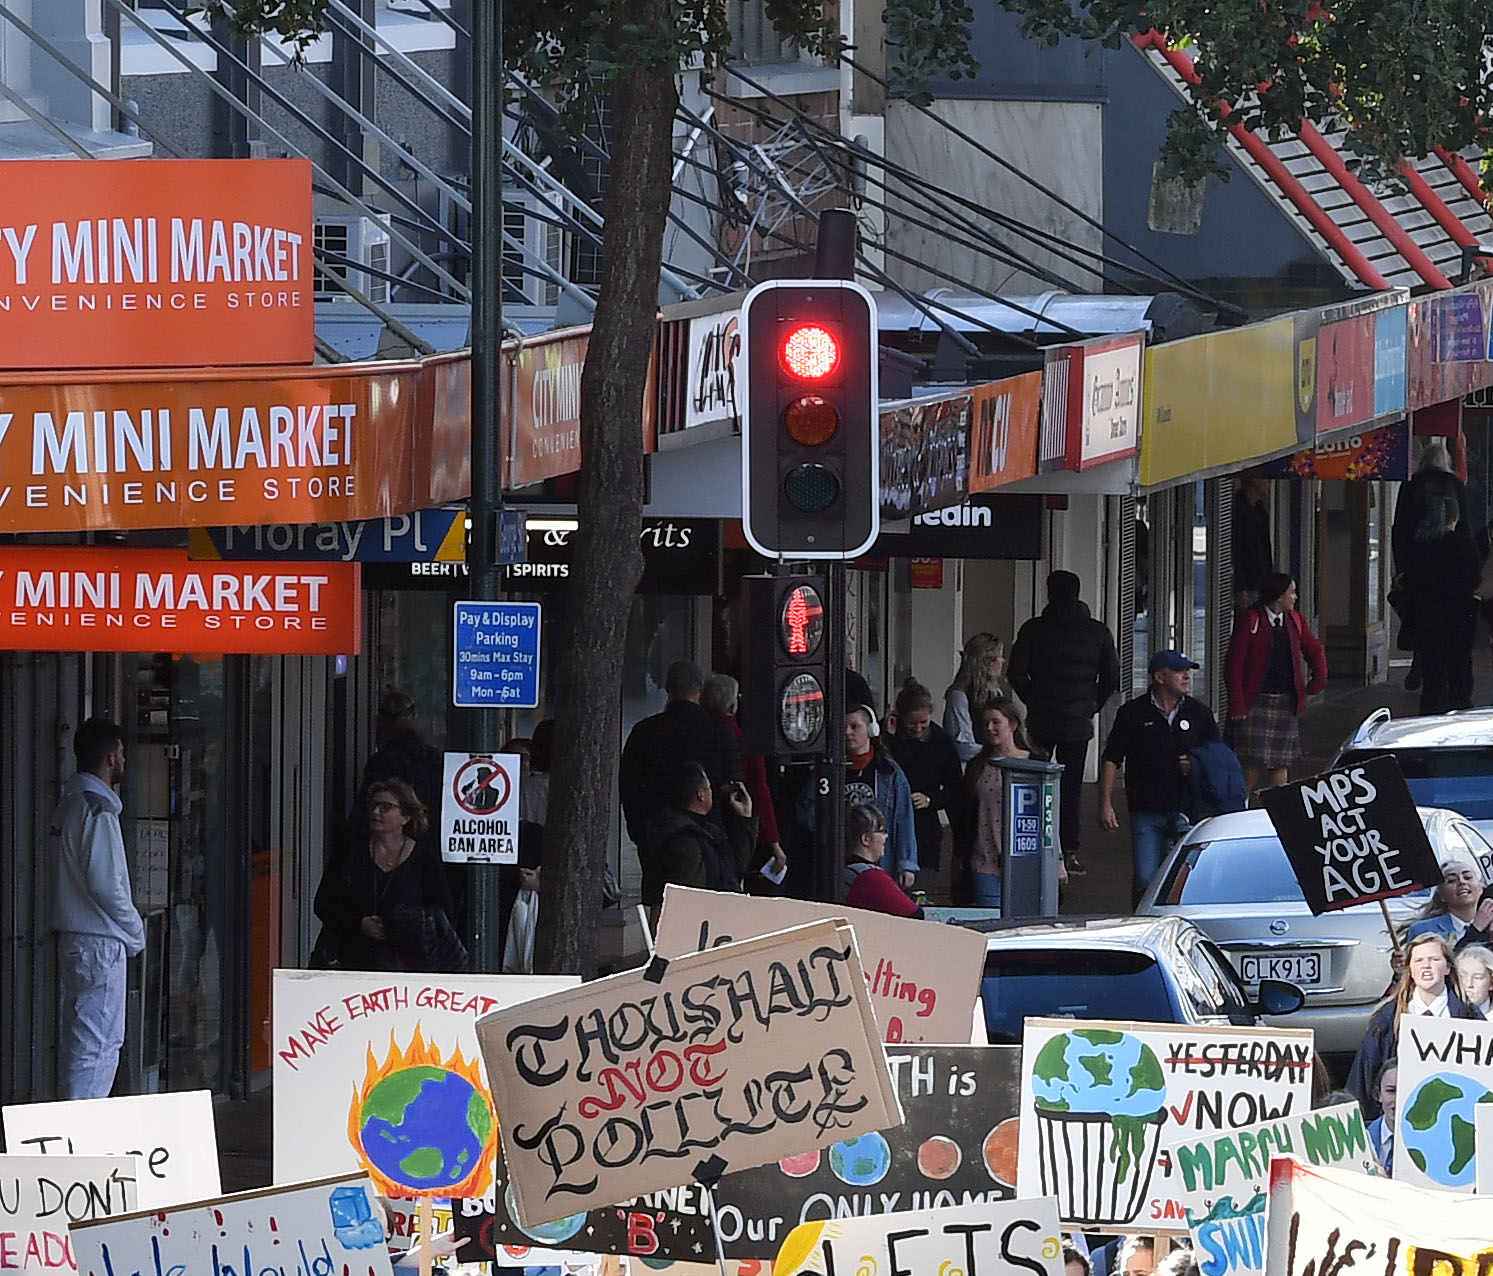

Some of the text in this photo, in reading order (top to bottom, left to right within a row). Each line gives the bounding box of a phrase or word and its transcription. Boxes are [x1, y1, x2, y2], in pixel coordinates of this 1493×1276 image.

[52, 217, 302, 284] MINI MARKET
[227, 288, 302, 309] STORE
[533, 363, 559, 429] CITY
[32, 403, 357, 476] MINI MARKET
[264, 476, 357, 499] STORE
[411, 562, 453, 576] BEER
[513, 564, 570, 578] SPIRITS
[15, 570, 328, 614] MINI MARKET
[205, 615, 327, 631] STORE
[460, 611, 535, 629] Pay & Display
[476, 631, 519, 648] Parking
[459, 651, 534, 664] 30mins Max Stay
[470, 668, 524, 682] 9am 6pm
[471, 685, 520, 699] Mon Sat
[818, 778, 830, 795] 3
[1017, 788, 1038, 814] P
[453, 819, 512, 836] ALCOHOL
[1321, 808, 1369, 839] ACT
[448, 838, 514, 855] BAN AREA
[1016, 836, 1038, 851] 1609
[1240, 954, 1320, 984] CLK913
[277, 984, 499, 1073] MAKE EARTH GREAT
[577, 1037, 728, 1120] NOT
[947, 1062, 978, 1097] is
[719, 1203, 784, 1245] Our
